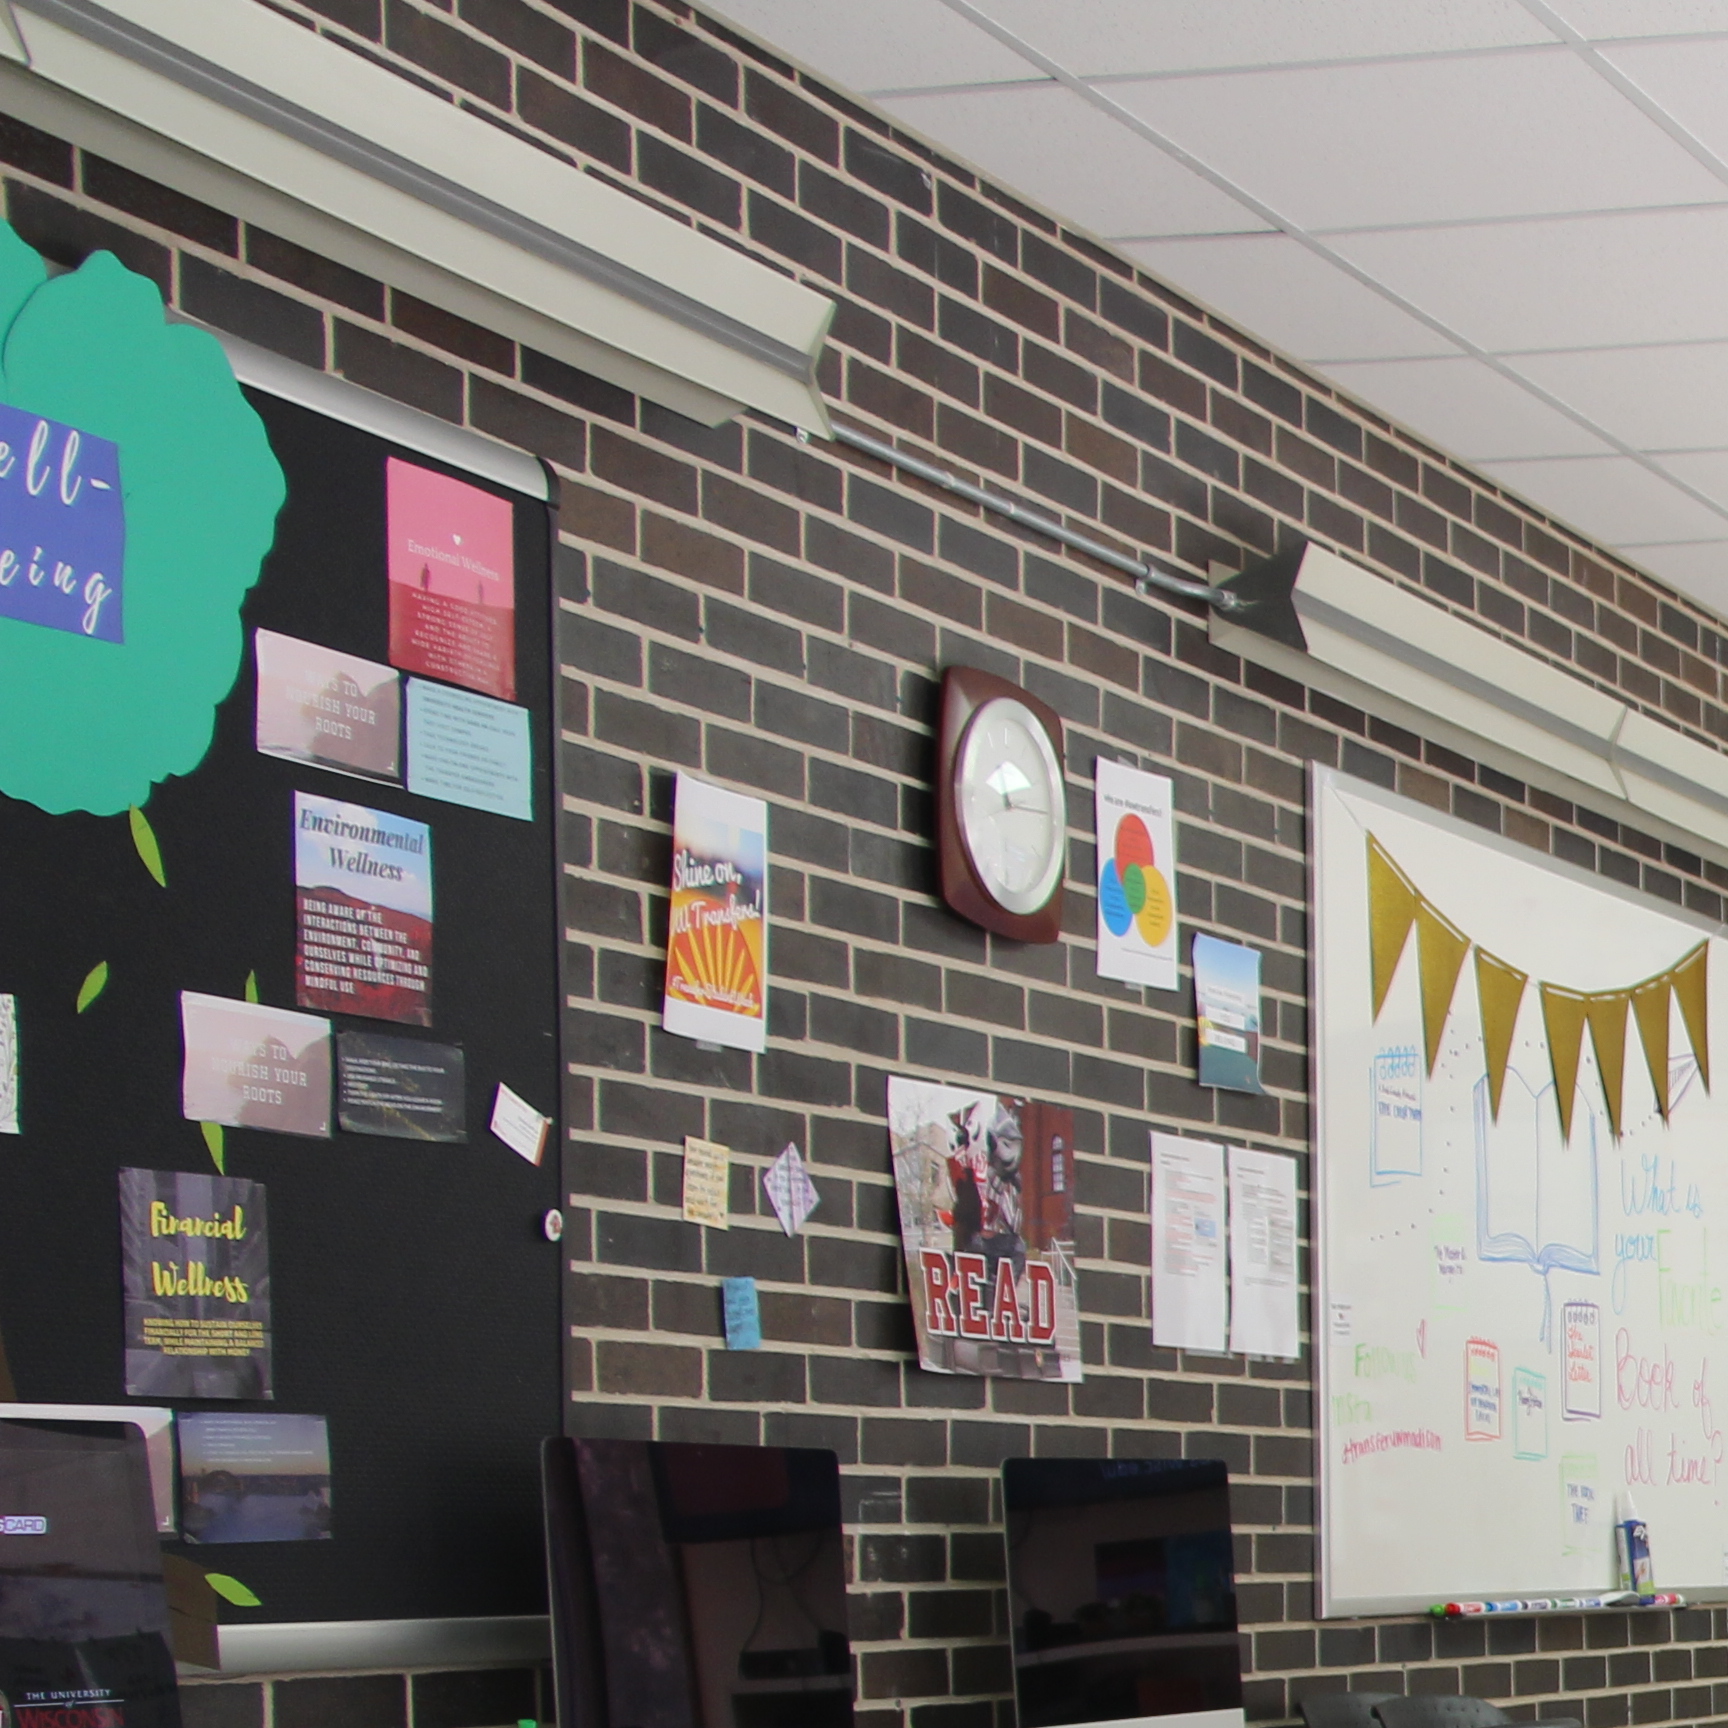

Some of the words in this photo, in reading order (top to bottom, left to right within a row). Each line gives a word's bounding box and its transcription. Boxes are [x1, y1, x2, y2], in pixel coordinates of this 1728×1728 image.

[407, 539, 460, 567] Emotional
[343, 680, 358, 698] TO
[315, 716, 352, 740] ROOTS
[346, 703, 376, 725] YOUR
[300, 807, 424, 855] Environmental
[329, 846, 404, 882] Wellness
[674, 849, 714, 892] Shine
[303, 898, 327, 914] BEING
[328, 903, 354, 919] AWARE
[368, 910, 383, 925] THE
[691, 889, 761, 930] Transfers!
[303, 914, 357, 935] INTERACTIONS
[359, 924, 394, 941] BETWEEN
[304, 944, 346, 963] OURSELVES
[348, 951, 372, 967] WHILE
[414, 963, 428, 978] AND
[304, 959, 351, 978] CONSERVING
[352, 966, 395, 985] RESOURCES
[395, 975, 425, 992] THROUGH
[305, 974, 338, 990] MINDFUL
[270, 1045, 287, 1061] TO
[274, 1068, 308, 1088] YOUR
[242, 1086, 282, 1105] ROOTS
[1620, 1153, 1681, 1218] What
[1686, 1183, 1703, 1219] is
[151, 1200, 247, 1240] Financial
[152, 1260, 249, 1303] Wellness
[1612, 1233, 1658, 1316] your
[919, 1247, 1057, 1346] READ
[1615, 1327, 1679, 1413] Book
[1692, 1357, 1712, 1440] of
[1625, 1427, 1657, 1487] all
[26, 1692, 46, 1700] THE
[51, 1688, 111, 1698] UNIVERSITY
